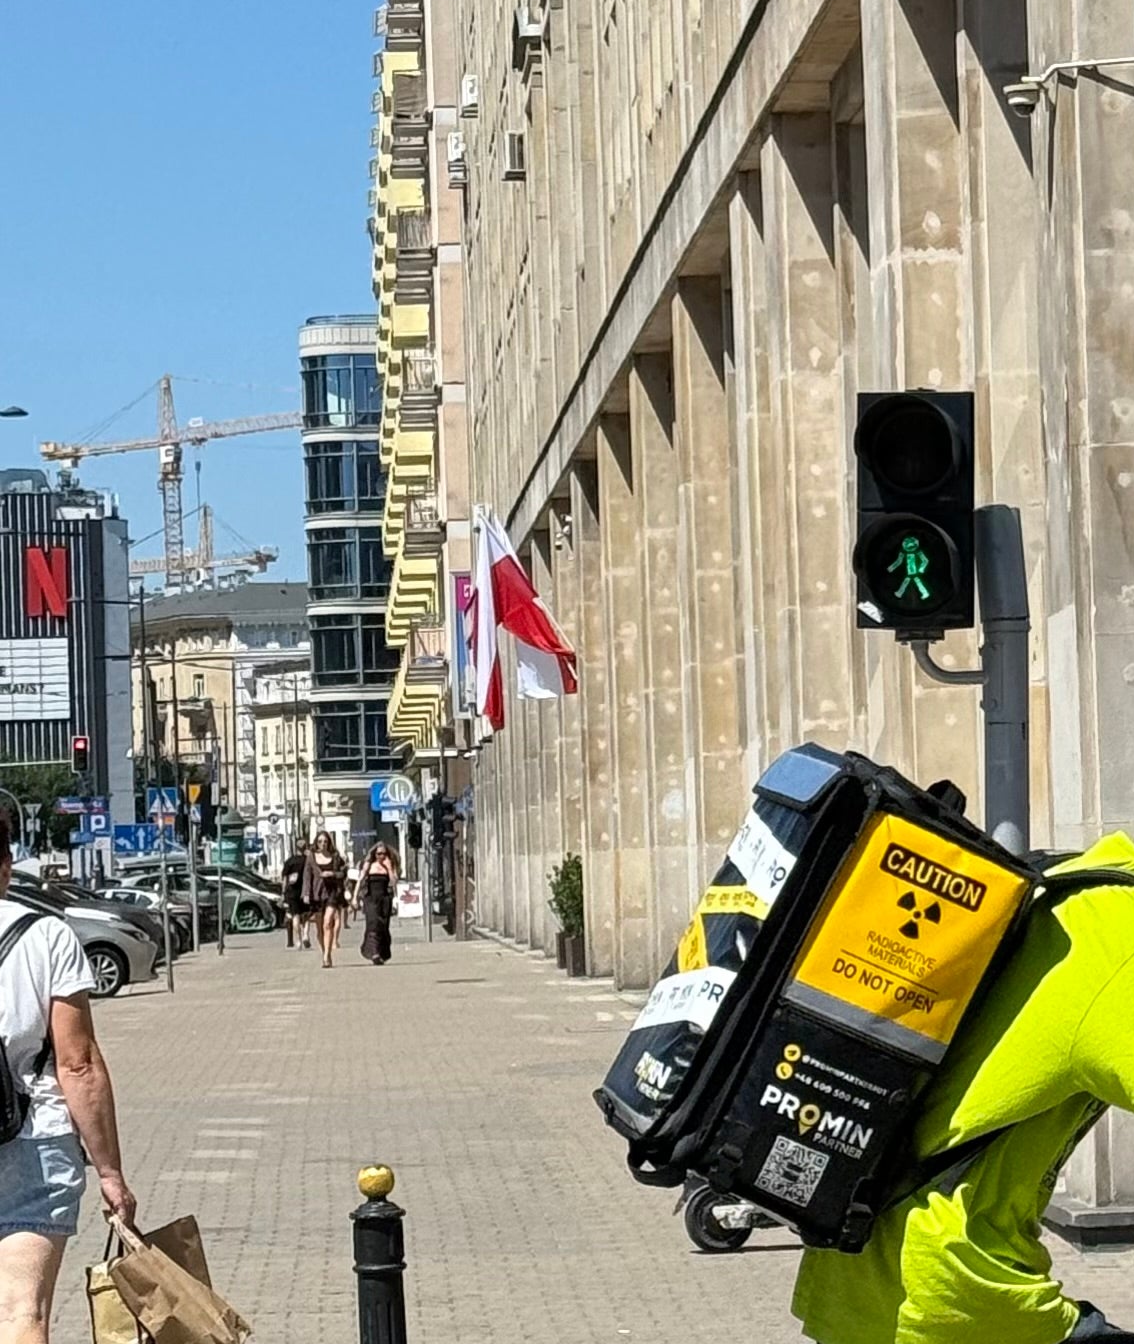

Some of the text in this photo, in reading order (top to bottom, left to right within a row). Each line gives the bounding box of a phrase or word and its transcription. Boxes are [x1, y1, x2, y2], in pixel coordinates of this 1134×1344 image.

[27, 547, 67, 617] N
[887, 849, 982, 906] CAUTION
[866, 930, 937, 971] RADIOACTIVE
[867, 944, 926, 978] MATERIALS
[832, 958, 936, 1014] DO NOT OPEN
[760, 1084, 873, 1149] PROMIN
[812, 1132, 863, 1159] PARTNER
